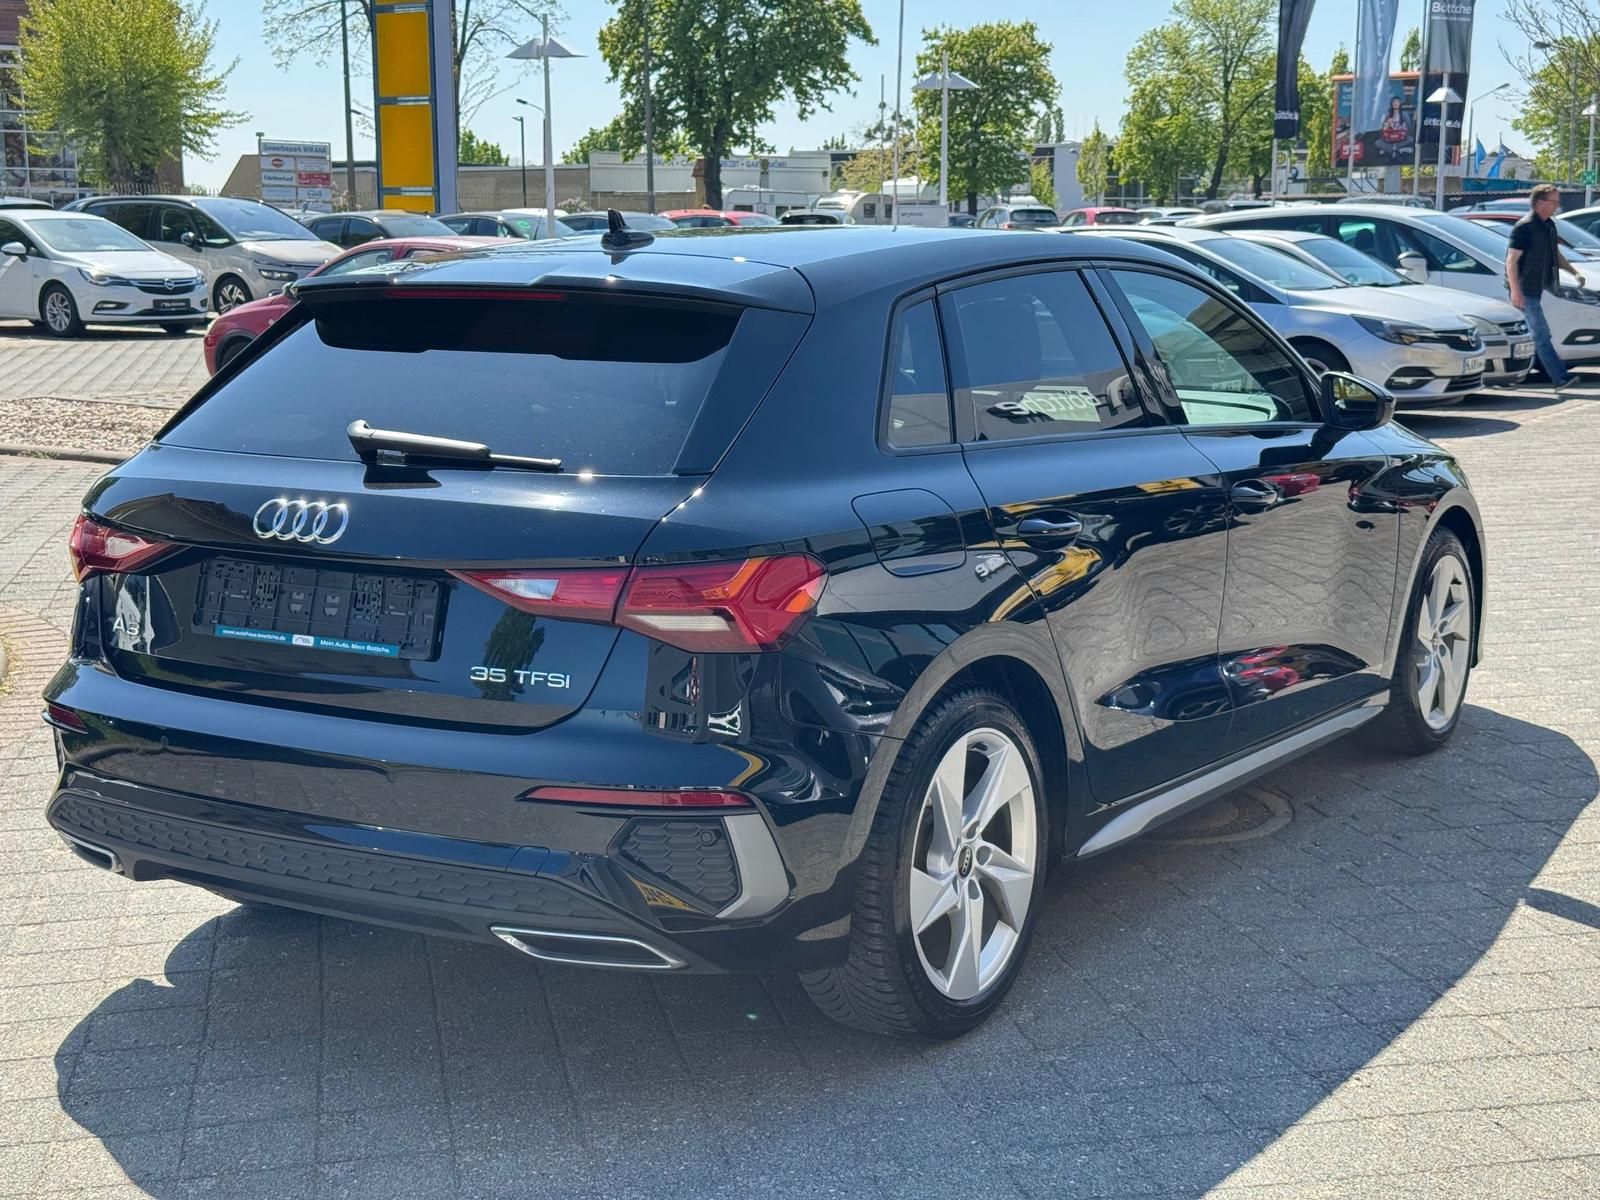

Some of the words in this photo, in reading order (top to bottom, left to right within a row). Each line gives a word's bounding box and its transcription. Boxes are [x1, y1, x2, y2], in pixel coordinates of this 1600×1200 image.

[112, 616, 141, 636] A3
[469, 665, 507, 683] 35
[513, 669, 571, 689] TFSI
